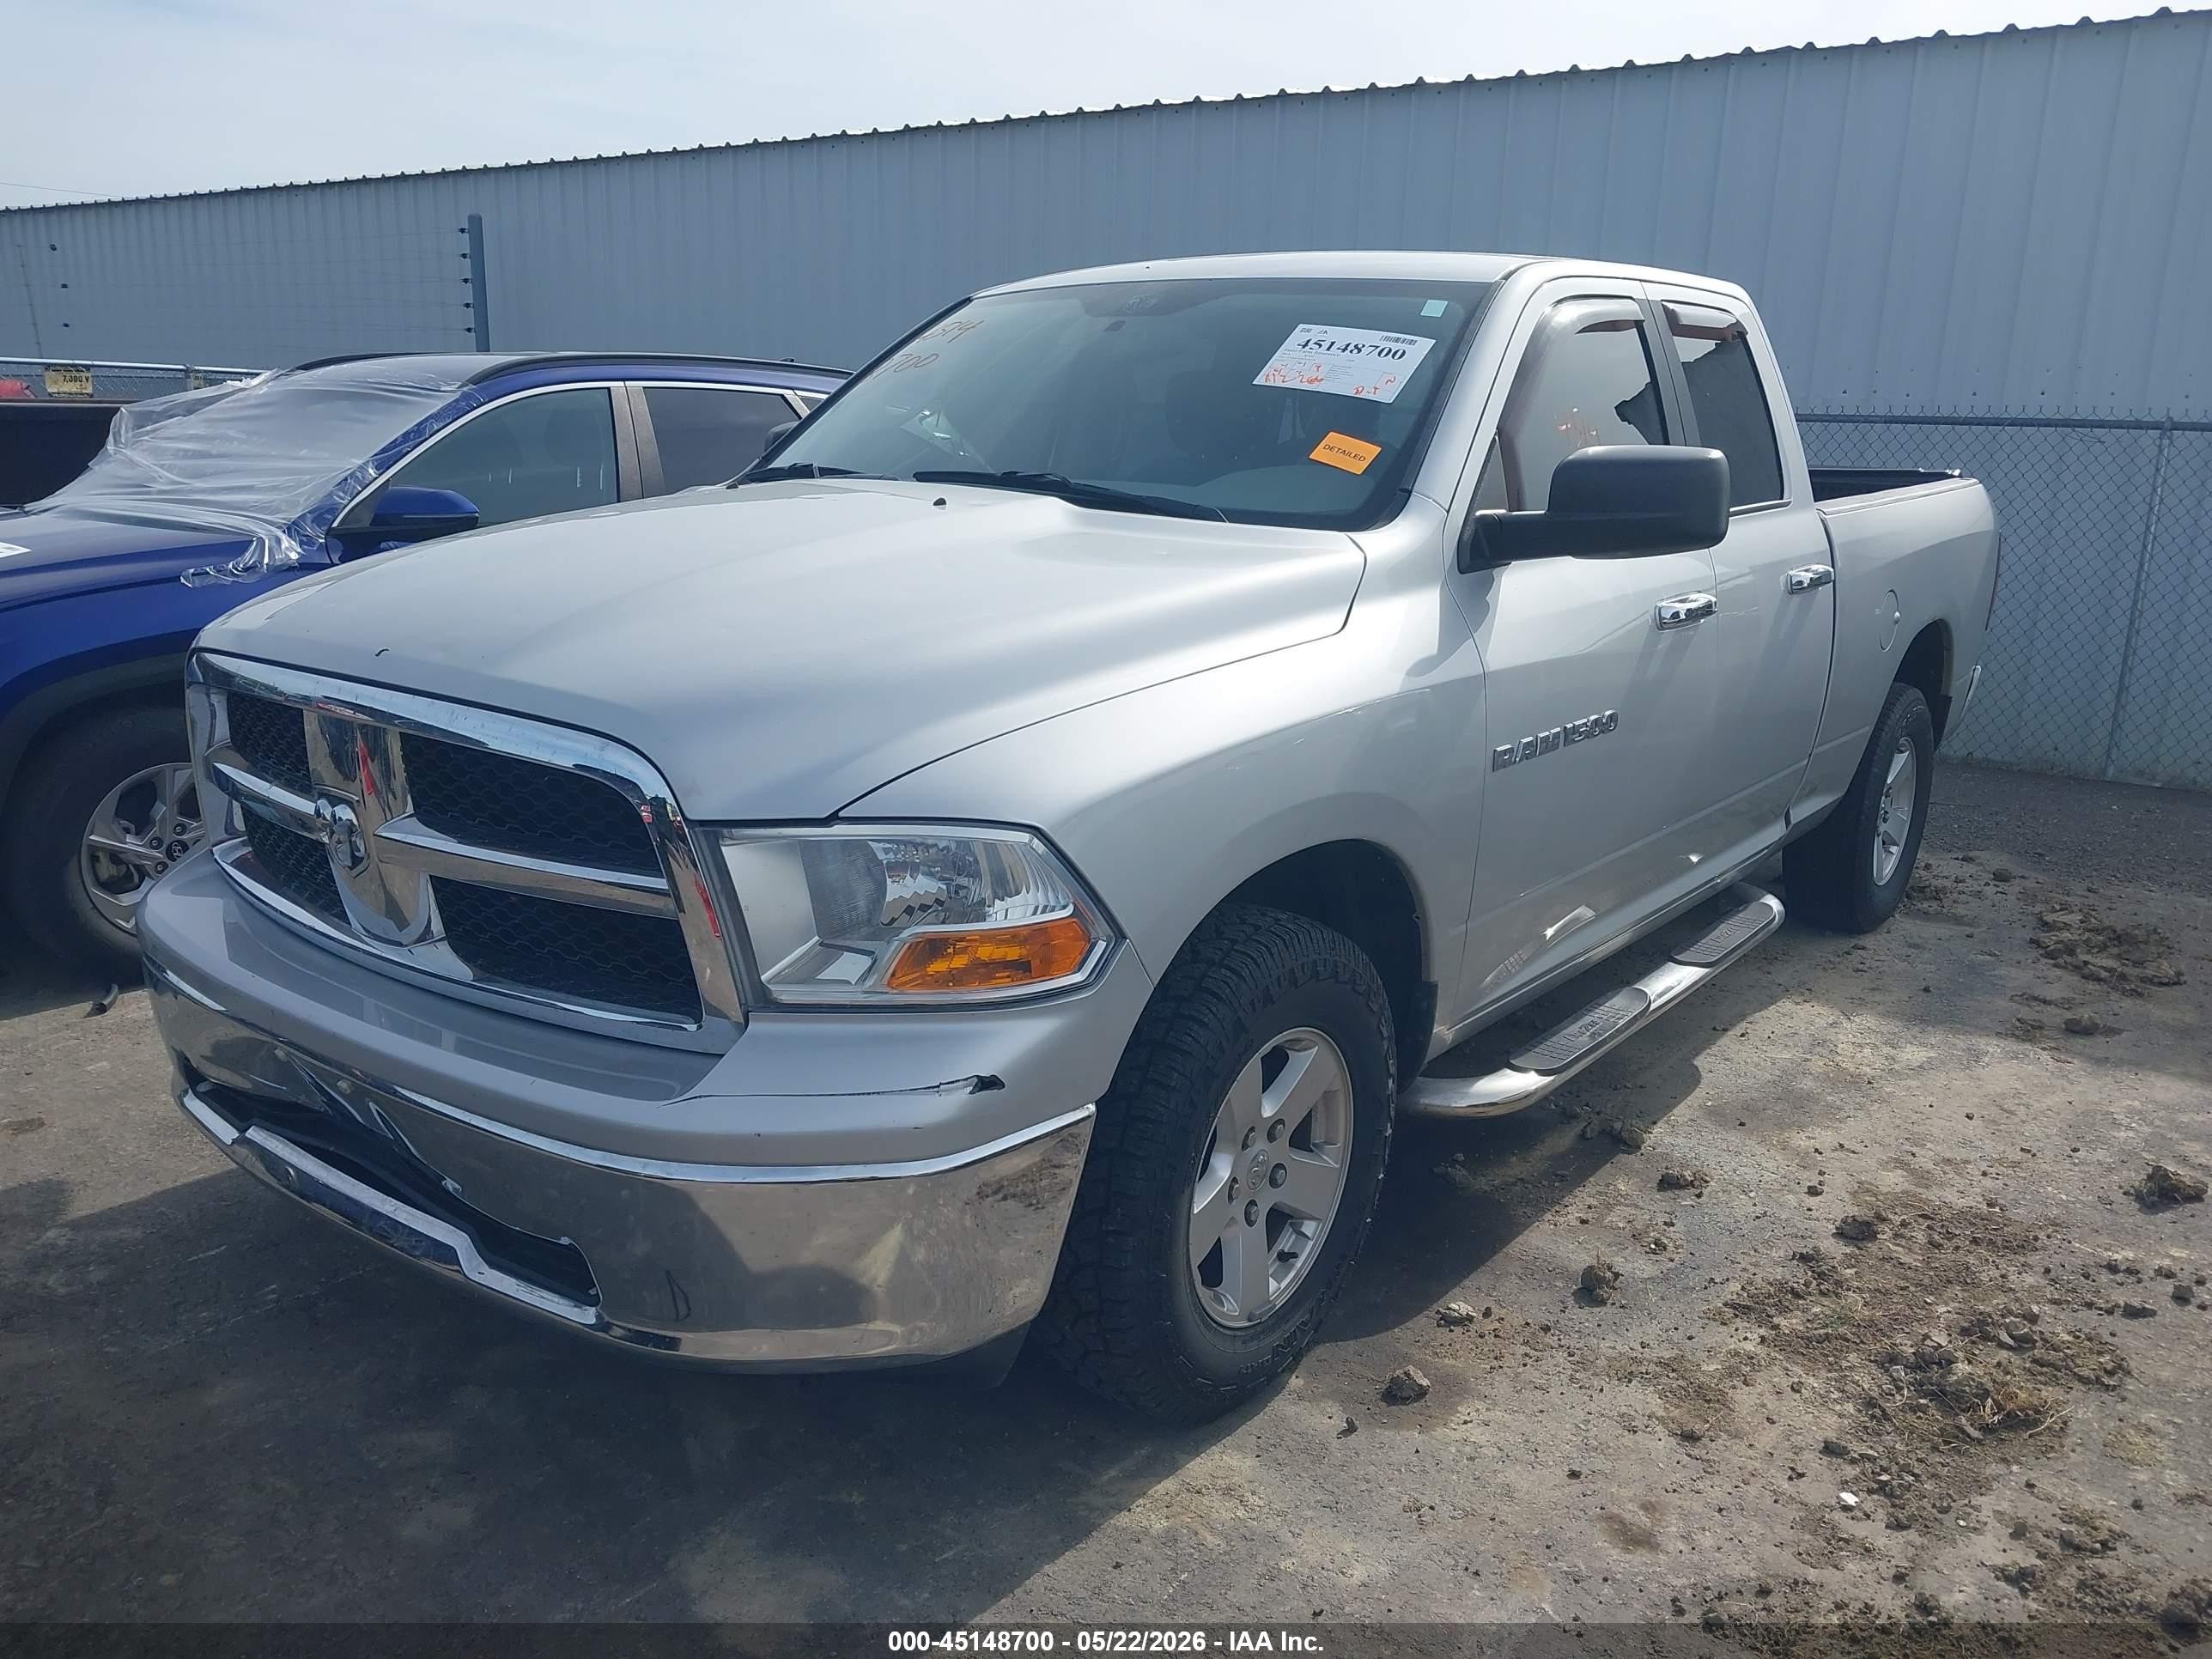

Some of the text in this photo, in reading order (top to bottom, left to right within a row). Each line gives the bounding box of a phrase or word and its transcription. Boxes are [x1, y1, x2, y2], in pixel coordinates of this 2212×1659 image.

[1296, 337, 1407, 361] 45148700
[1322, 443, 1367, 462] DETAILED
[1492, 708, 1620, 773] RAM 1500
